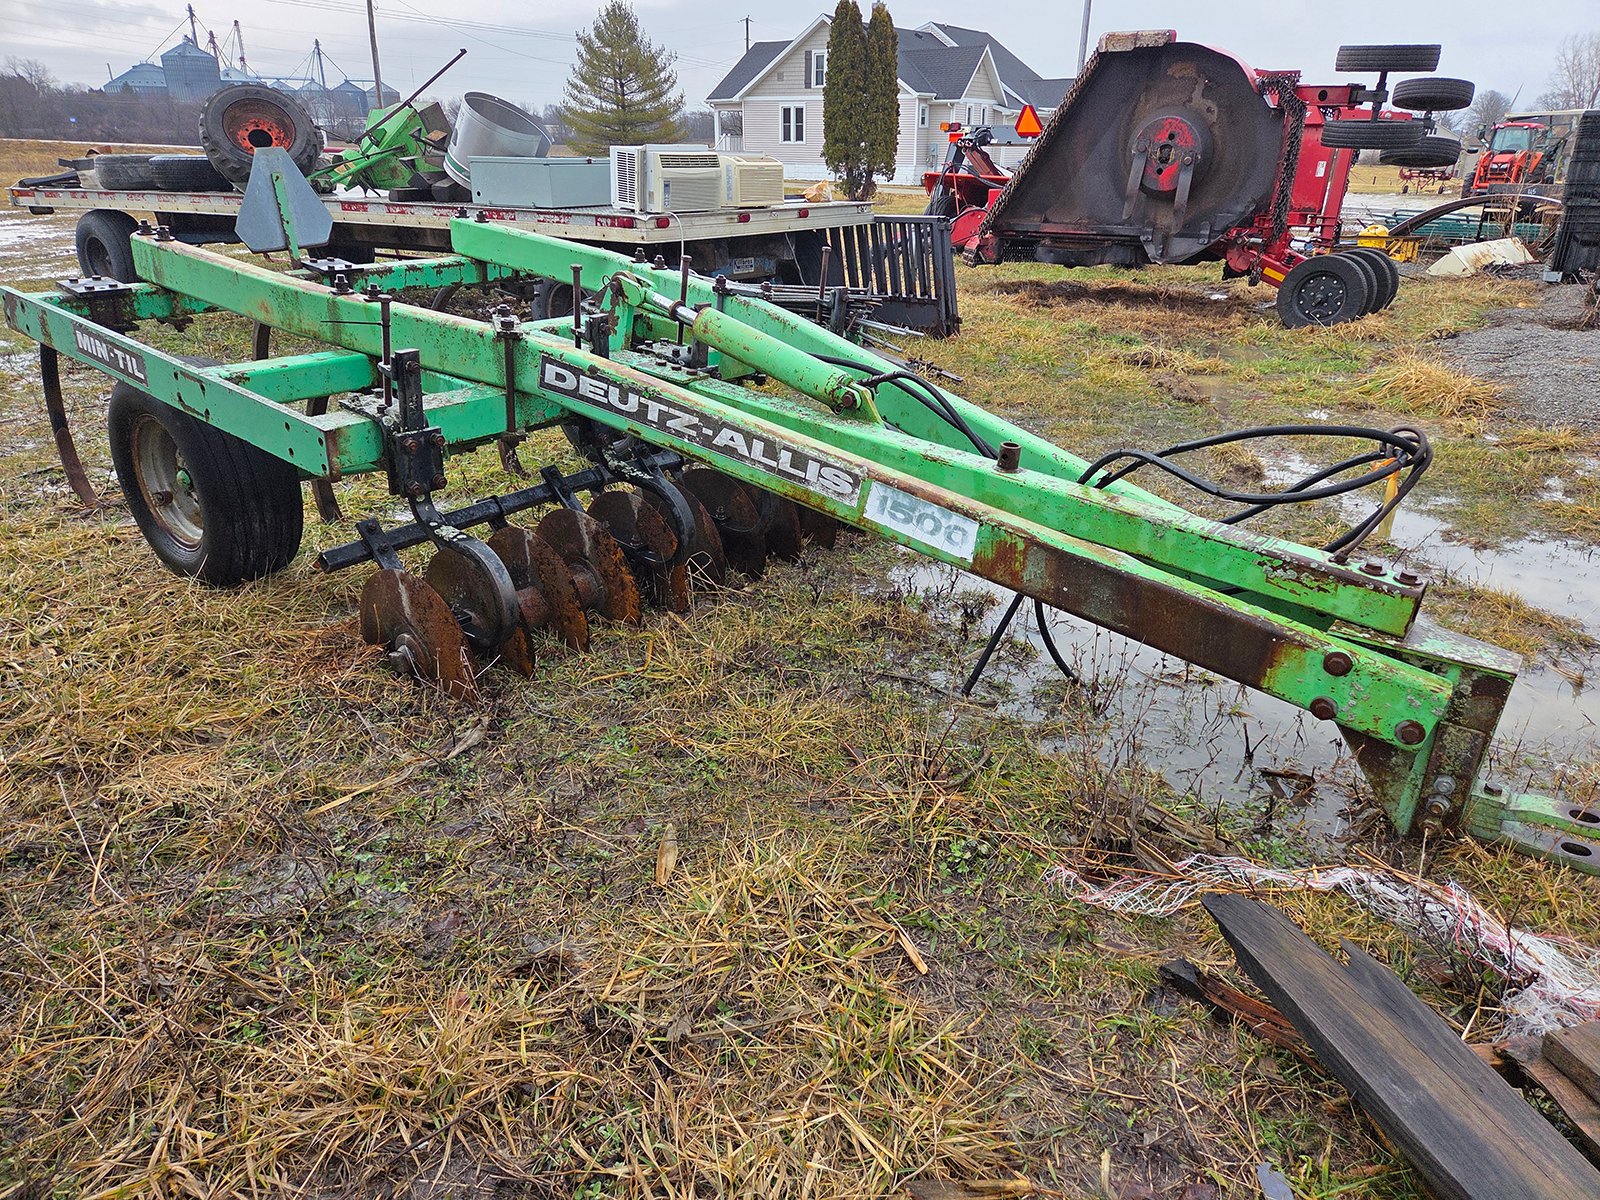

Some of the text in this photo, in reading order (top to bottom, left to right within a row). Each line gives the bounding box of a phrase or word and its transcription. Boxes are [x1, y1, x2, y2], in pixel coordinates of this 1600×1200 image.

[75, 330, 145, 380] MIN-TIL
[544, 363, 854, 494] DEUTZ-ALLIS
[876, 494, 969, 548] 1500
